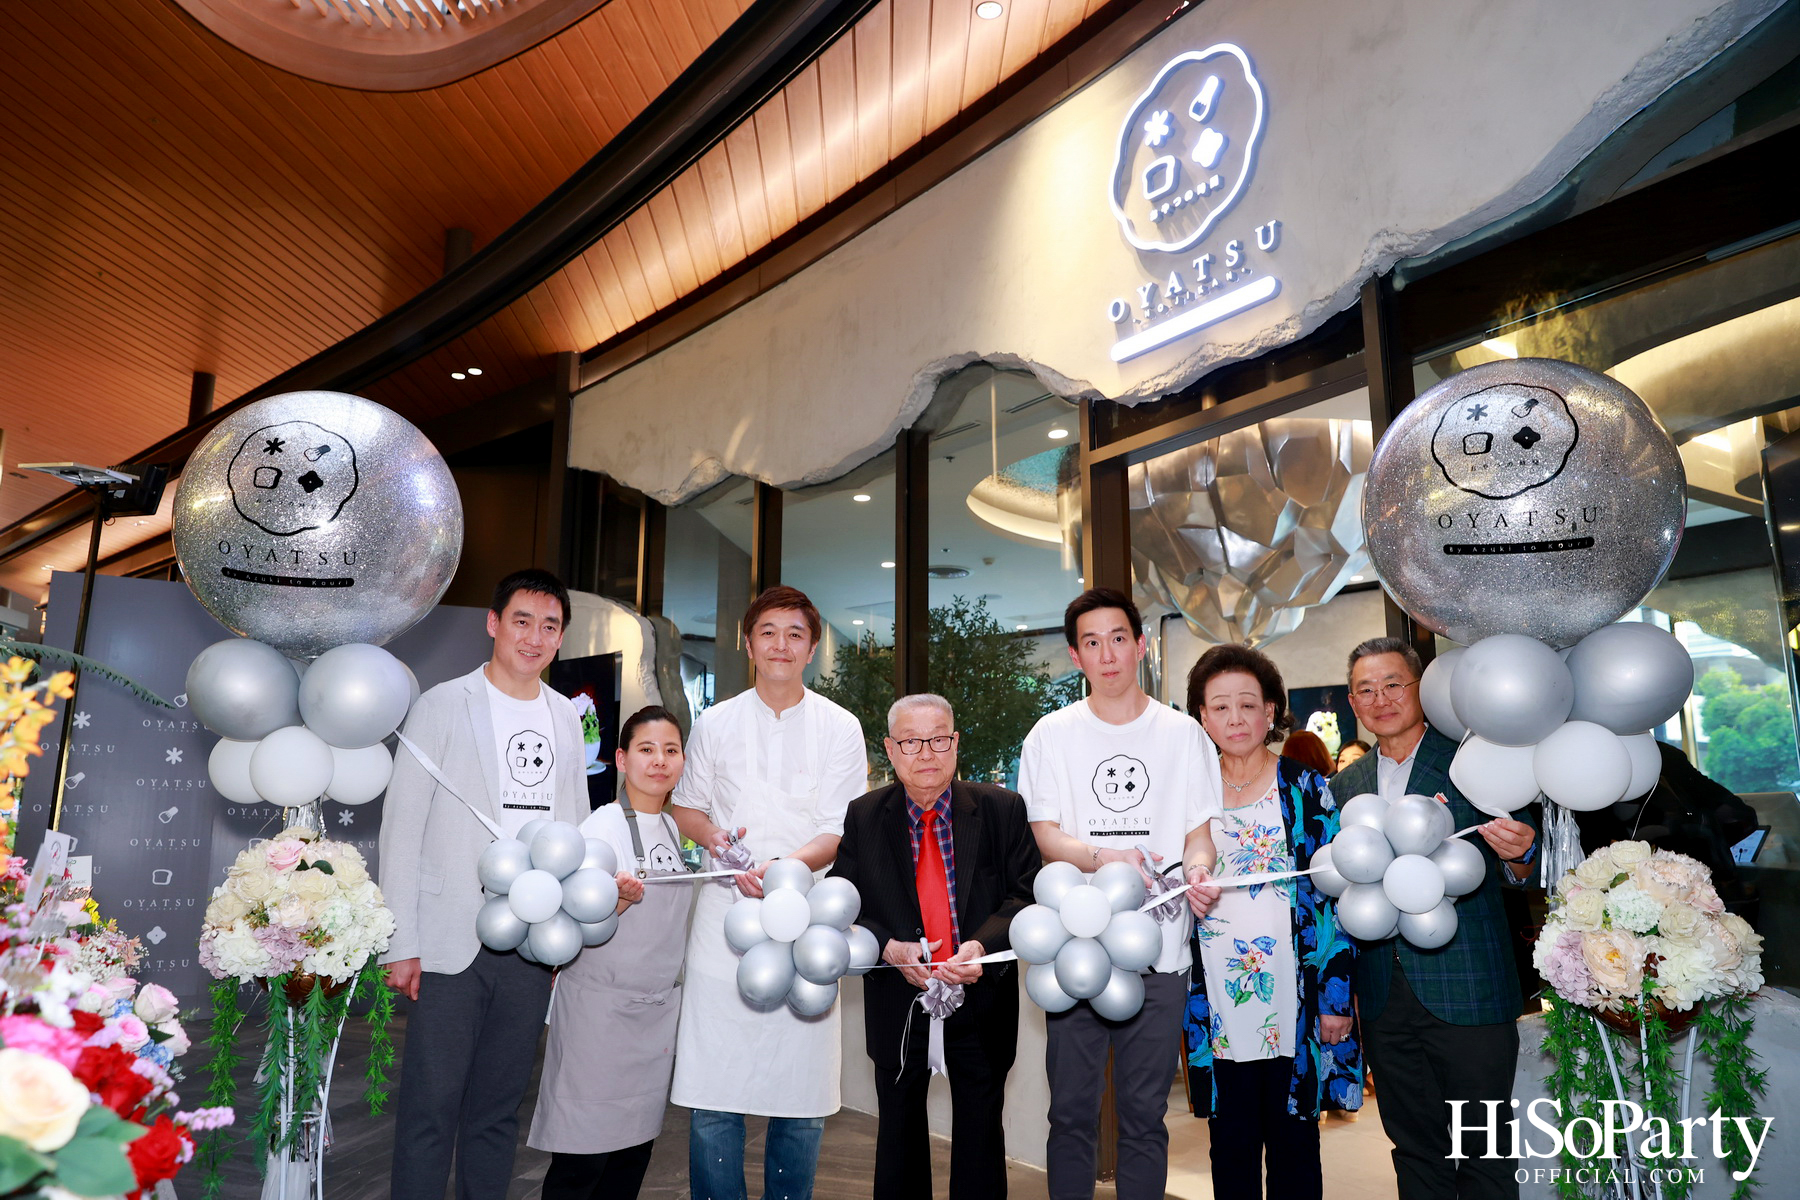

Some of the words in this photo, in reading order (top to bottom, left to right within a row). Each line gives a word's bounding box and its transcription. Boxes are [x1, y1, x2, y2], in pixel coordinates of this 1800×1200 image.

[1108, 219, 1280, 324] OYATSU
[1438, 506, 1598, 529] OYATSU
[1472, 545, 1512, 553] Azuki
[1522, 544, 1537, 552] to
[1547, 540, 1589, 550] Kouri
[218, 540, 357, 566] OYATSU
[245, 573, 280, 584] Azuki
[289, 578, 302, 586] to
[311, 579, 349, 587] Kouri
[136, 778, 206, 789] OYATSU
[502, 790, 553, 801] OYATSU
[33, 803, 109, 814] OATSU
[227, 807, 281, 817] OYATS
[1088, 817, 1151, 826] OYATSU
[129, 838, 201, 847] OYATSU
[123, 898, 195, 908] OYATSU
[143, 959, 190, 969] ATSU
